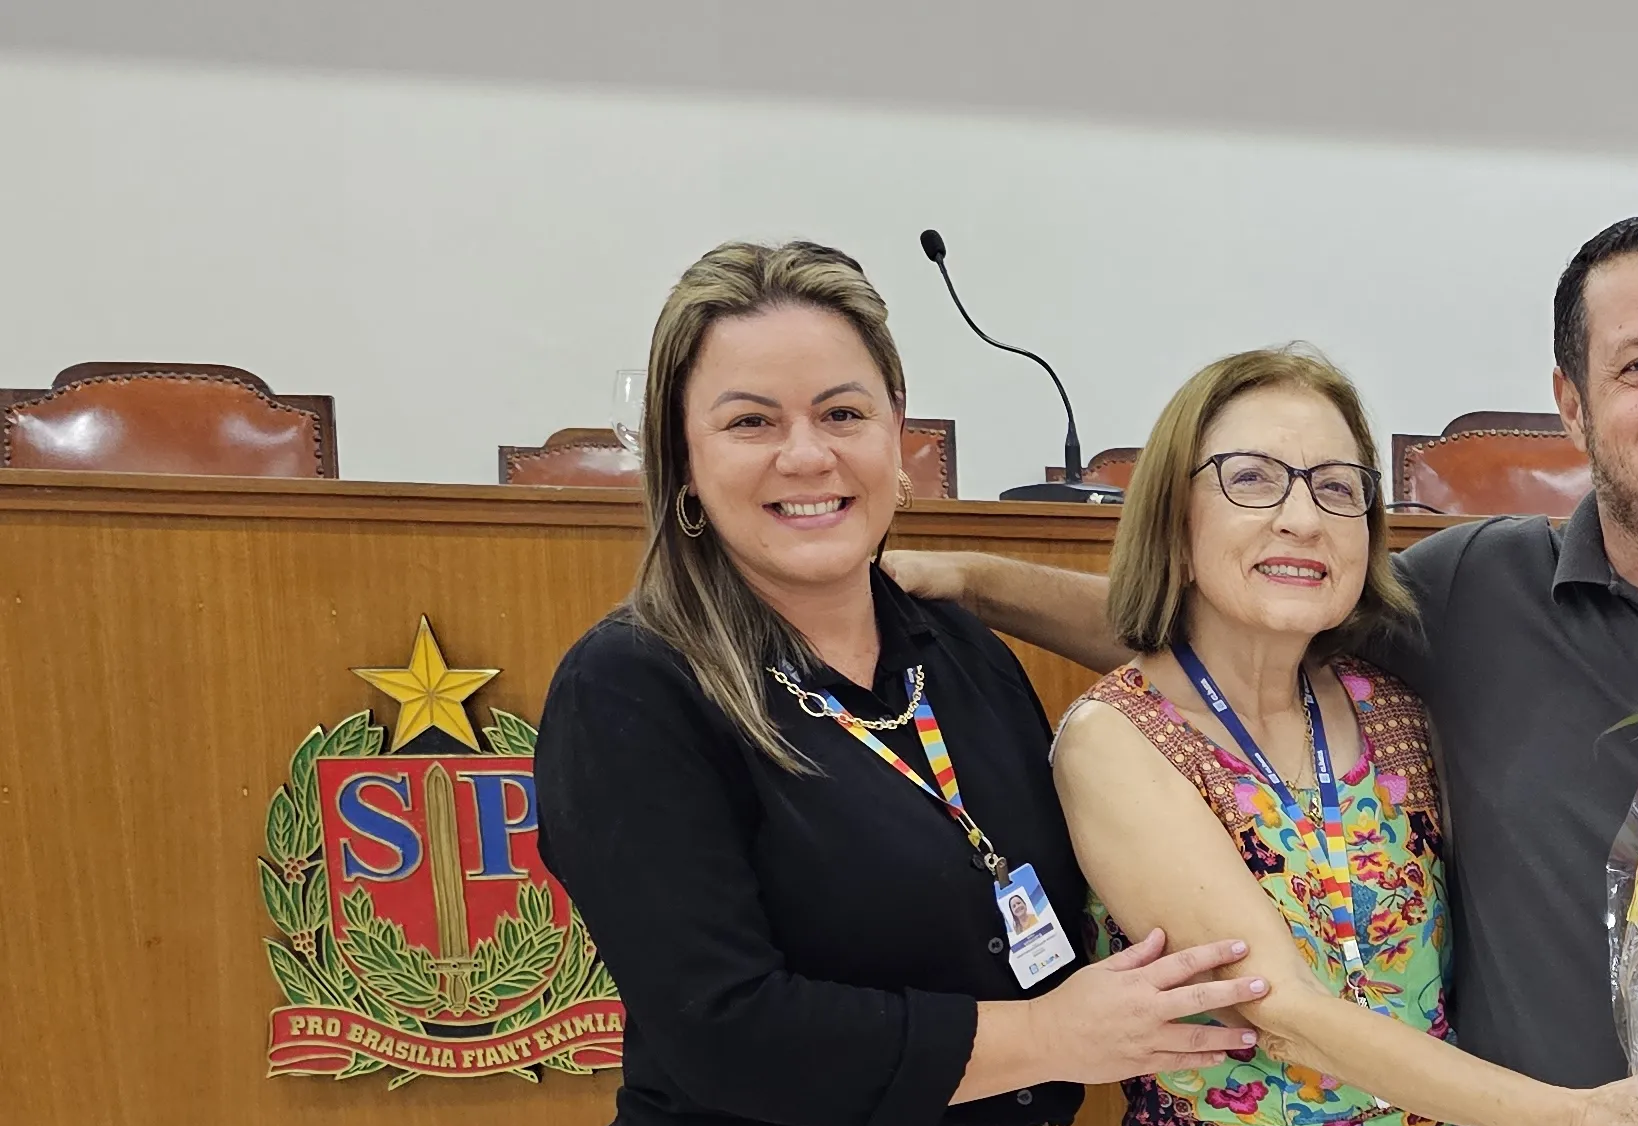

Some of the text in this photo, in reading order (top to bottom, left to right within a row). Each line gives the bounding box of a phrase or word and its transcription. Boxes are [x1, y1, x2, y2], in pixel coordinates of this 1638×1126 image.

[289, 1013, 623, 1069] PRO BRASILIA FIANT EXIMIA
